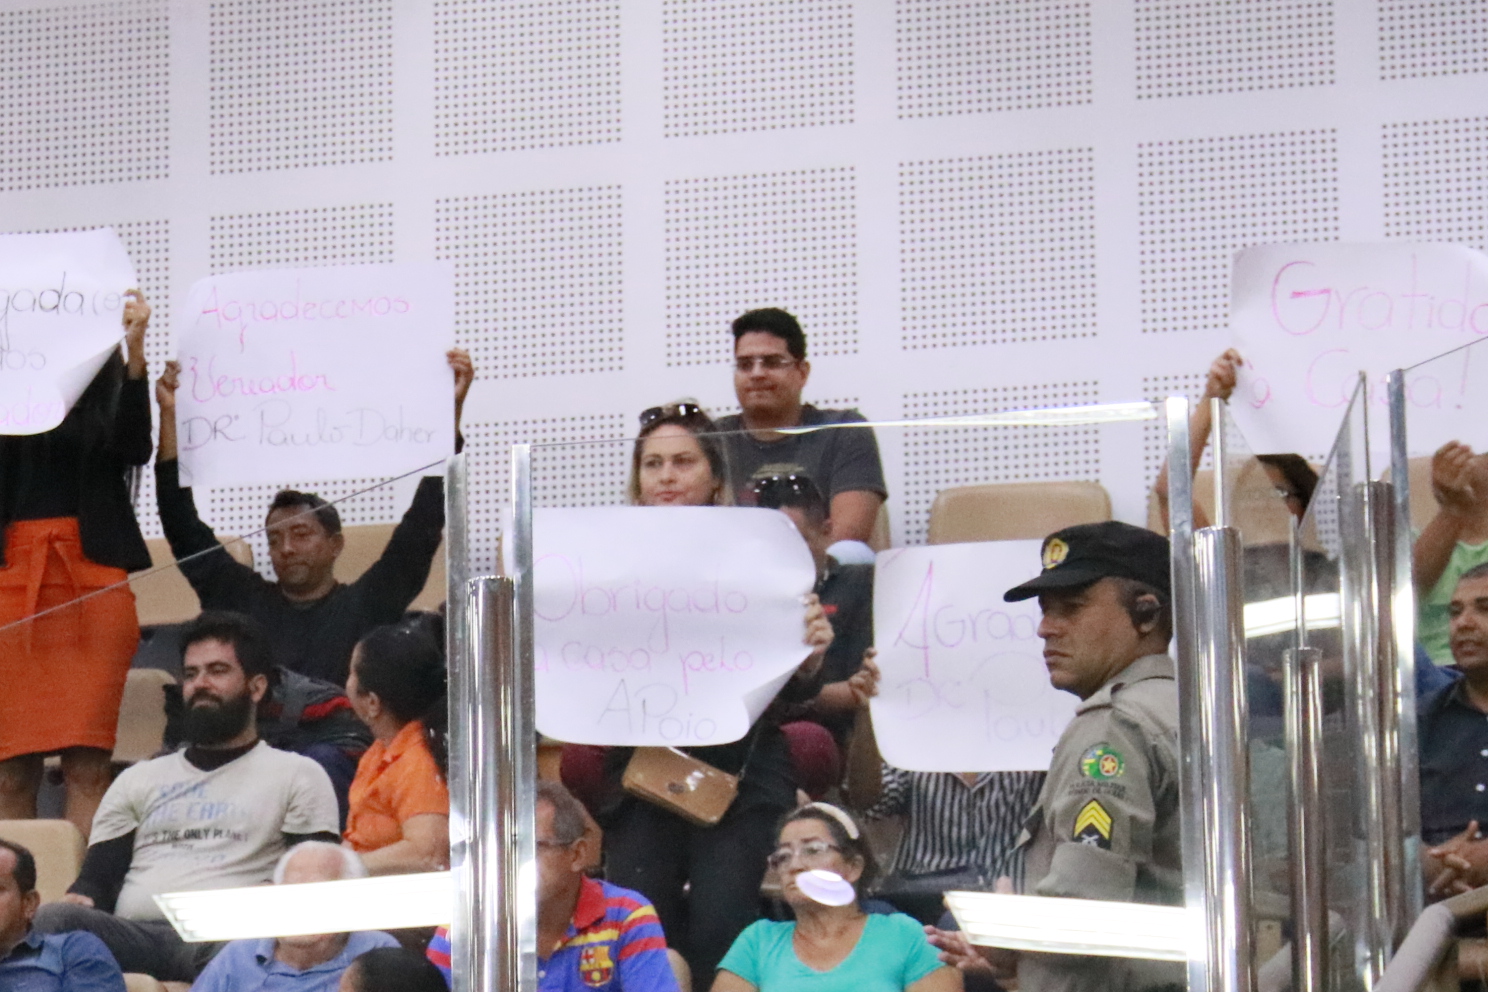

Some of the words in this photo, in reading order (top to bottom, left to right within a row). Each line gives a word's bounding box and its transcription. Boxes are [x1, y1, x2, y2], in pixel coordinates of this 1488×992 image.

[252, 399, 348, 447] Paulo
[345, 405, 438, 447] Daher
[680, 635, 753, 695] pelo
[184, 828, 210, 840] ONLY
